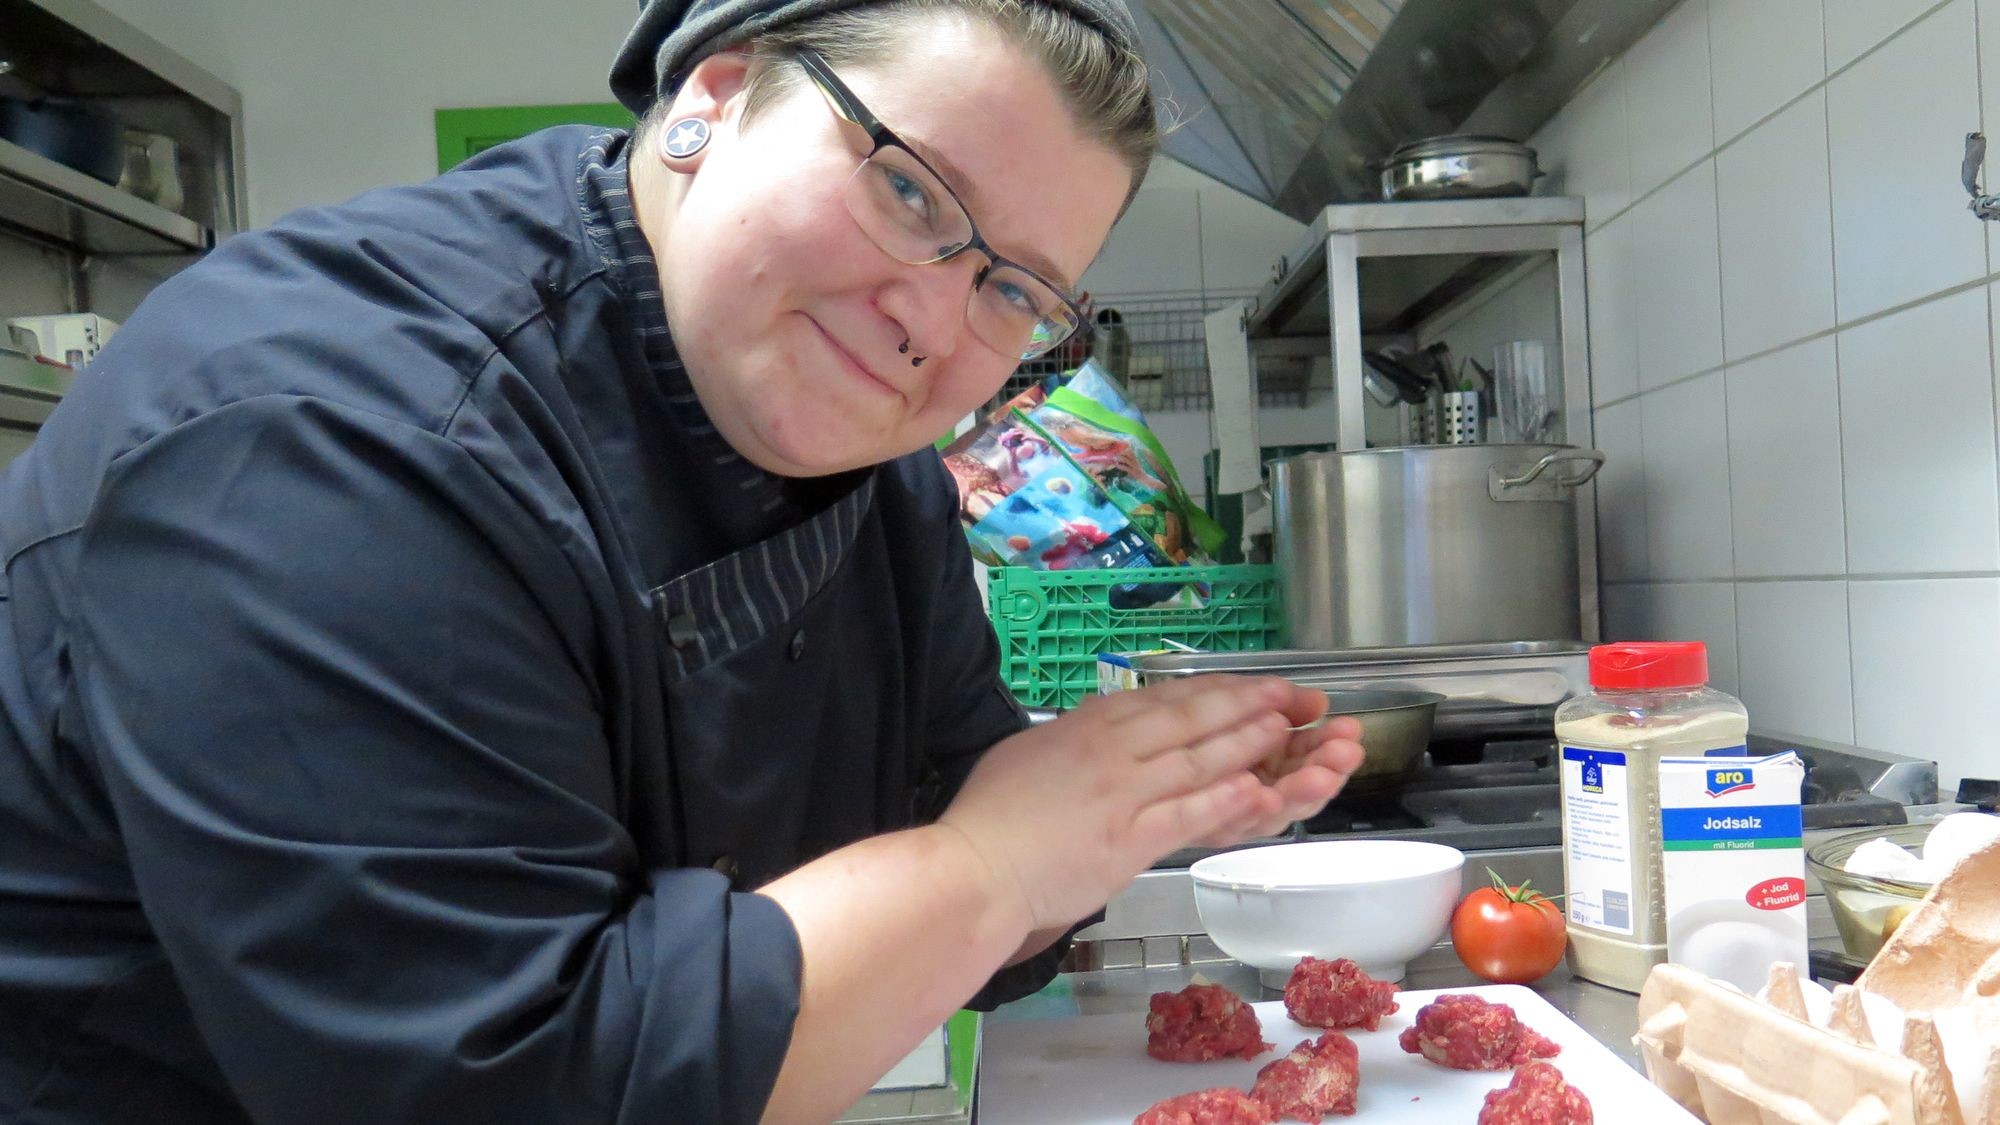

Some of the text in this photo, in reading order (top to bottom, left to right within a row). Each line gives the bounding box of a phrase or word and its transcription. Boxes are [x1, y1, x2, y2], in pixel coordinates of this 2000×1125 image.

[1715, 771, 1744, 784] aro
[1703, 816, 1762, 830] Jodsalz
[1727, 841, 1755, 849] Fluorid
[1770, 882, 1789, 893] Jod
[1764, 892, 1800, 906] Fluorid
